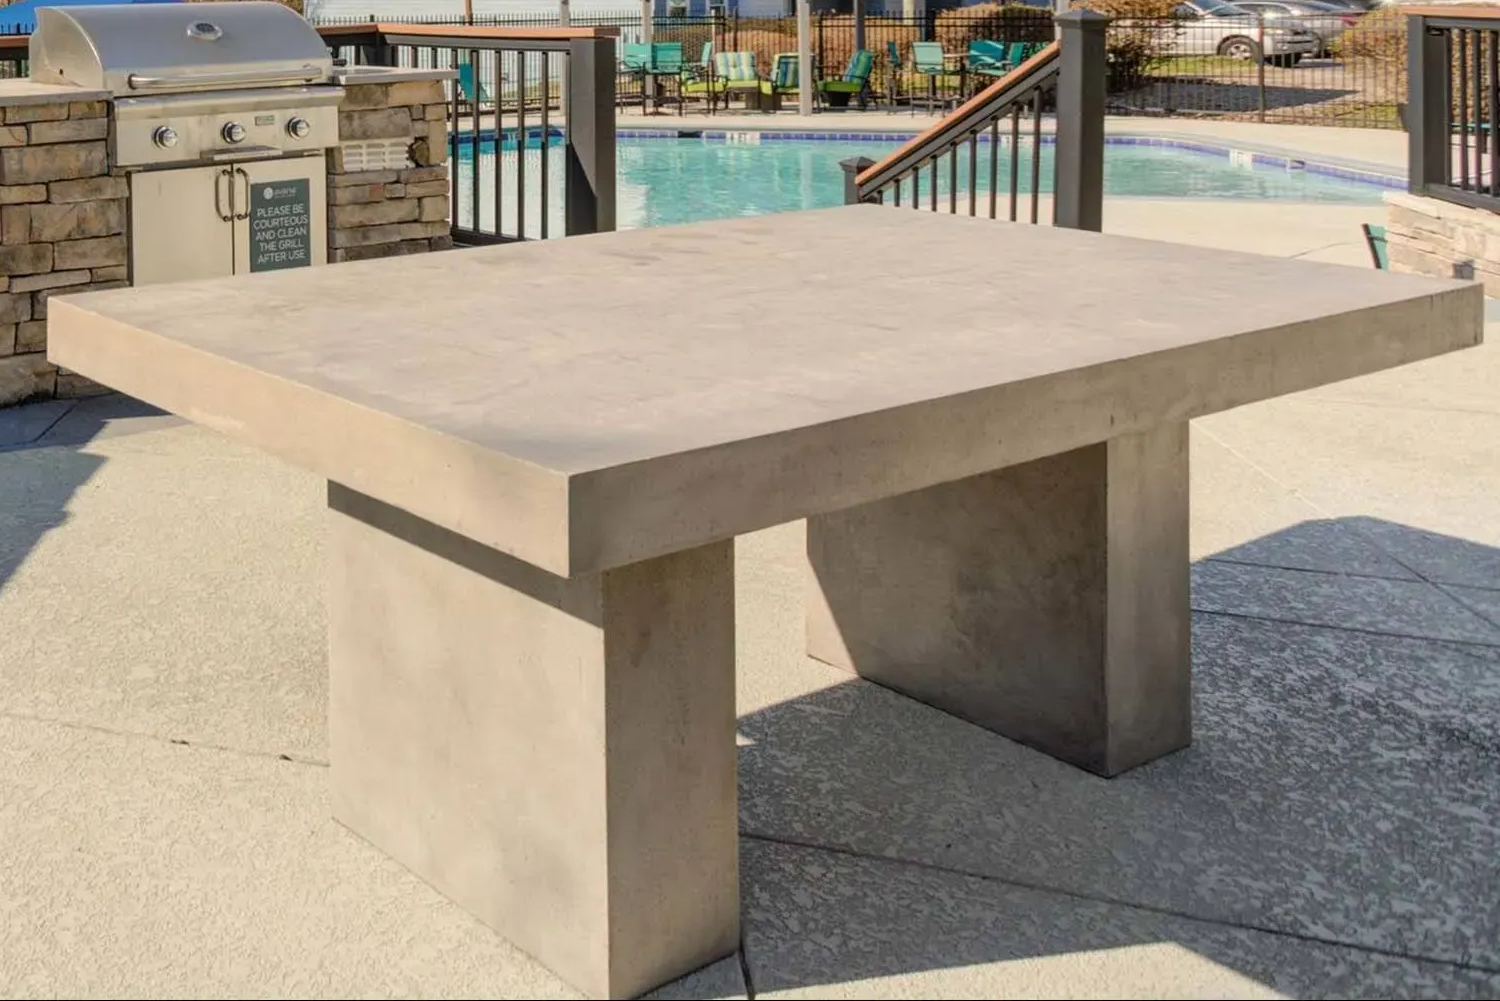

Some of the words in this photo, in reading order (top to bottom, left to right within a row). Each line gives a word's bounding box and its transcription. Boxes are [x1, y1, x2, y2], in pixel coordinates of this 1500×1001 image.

[257, 204, 290, 217] PLEASE
[292, 203, 304, 214] BE
[253, 214, 308, 230] COURTEOUS
[255, 230, 275, 240] AND
[277, 226, 307, 238] CLEAN
[259, 241, 277, 252] THE
[278, 239, 304, 250] GRILL
[257, 251, 286, 264] AFTER
[288, 249, 306, 261] USE
